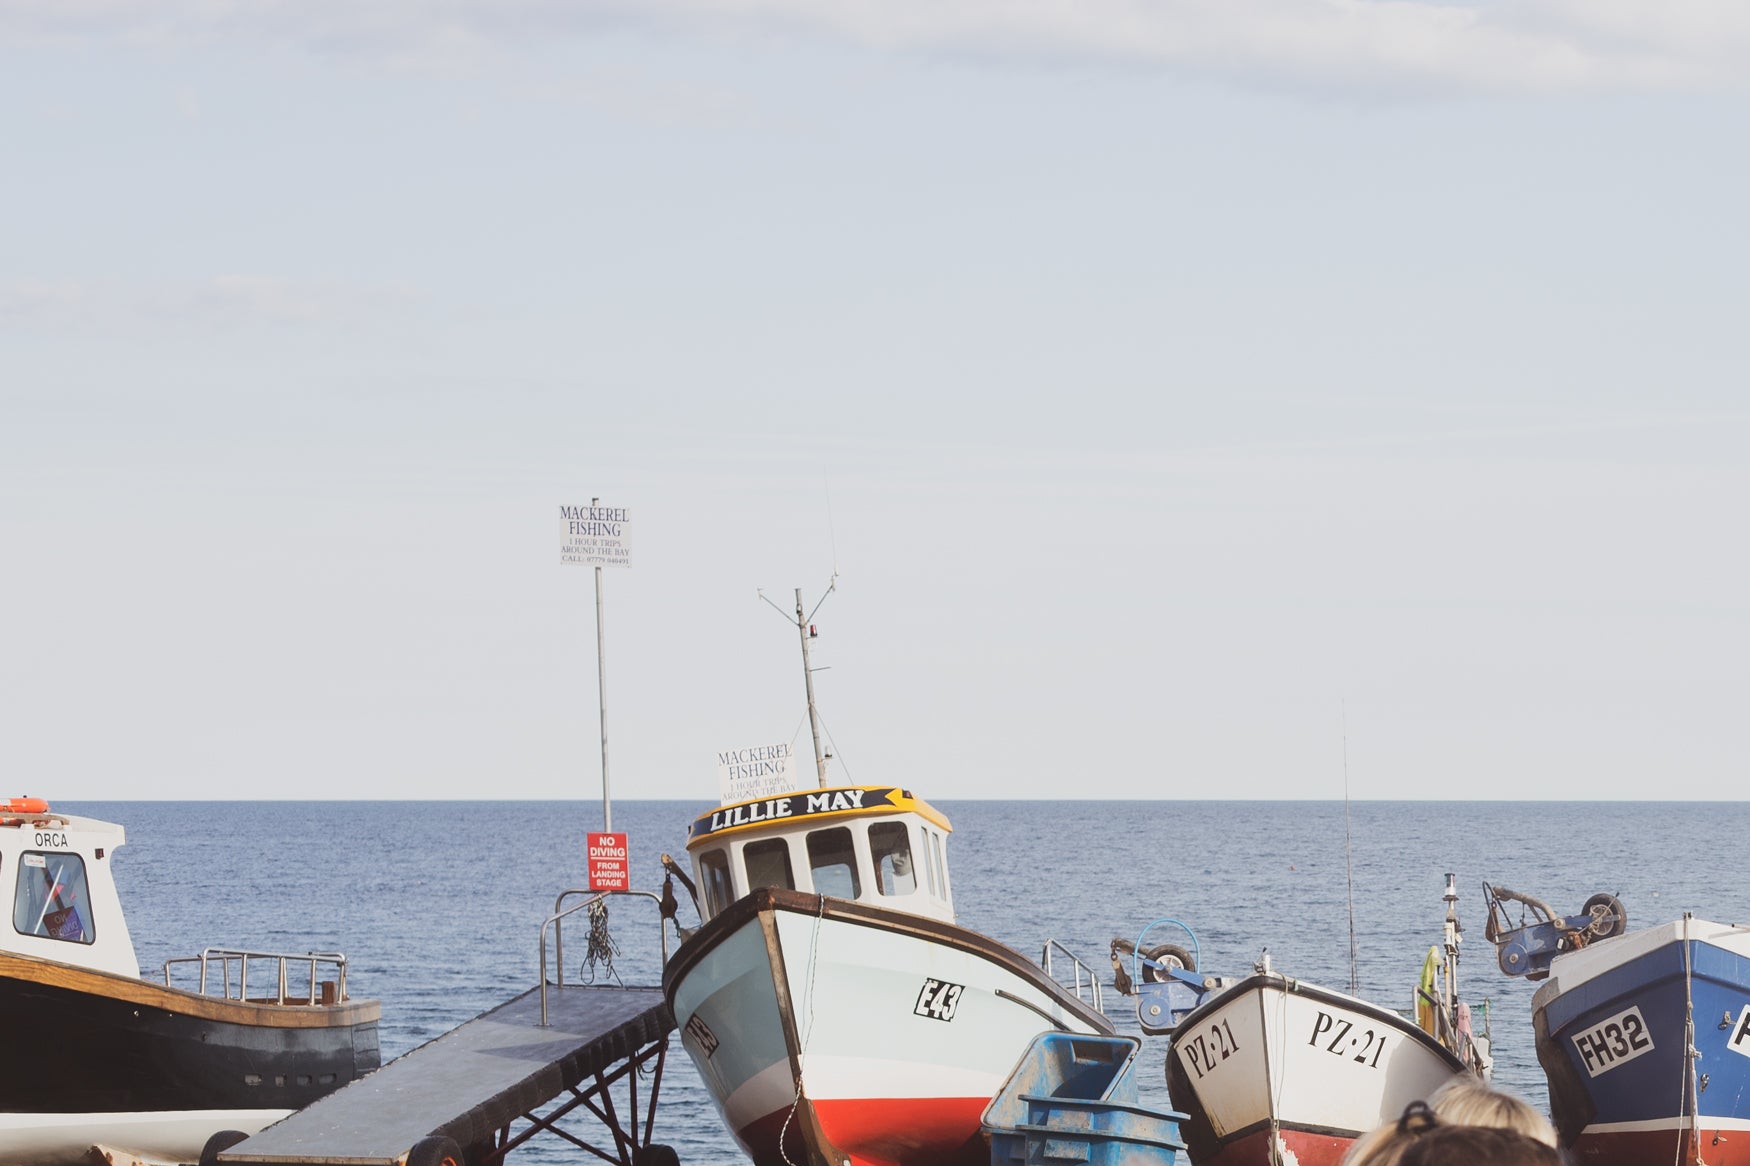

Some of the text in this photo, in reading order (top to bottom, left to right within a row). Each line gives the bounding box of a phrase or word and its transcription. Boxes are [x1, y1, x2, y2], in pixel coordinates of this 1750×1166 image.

[560, 506, 629, 522] MACKEREL
[569, 521, 621, 537] FISHING
[574, 538, 598, 547] HOUR
[600, 539, 621, 548] TRIPS
[561, 546, 630, 556] AROUND THE BAY
[718, 744, 792, 766] MACKEREL
[729, 760, 785, 780] FISHING
[710, 790, 865, 832] LILLIE MAY
[35, 833, 68, 847] ORCA
[599, 837, 615, 846] NO
[590, 847, 625, 857] DIVING
[591, 870, 626, 878] LANDING
[596, 879, 622, 887] STAGE
[916, 979, 962, 1021] E43
[1575, 1013, 1651, 1072] FH32
